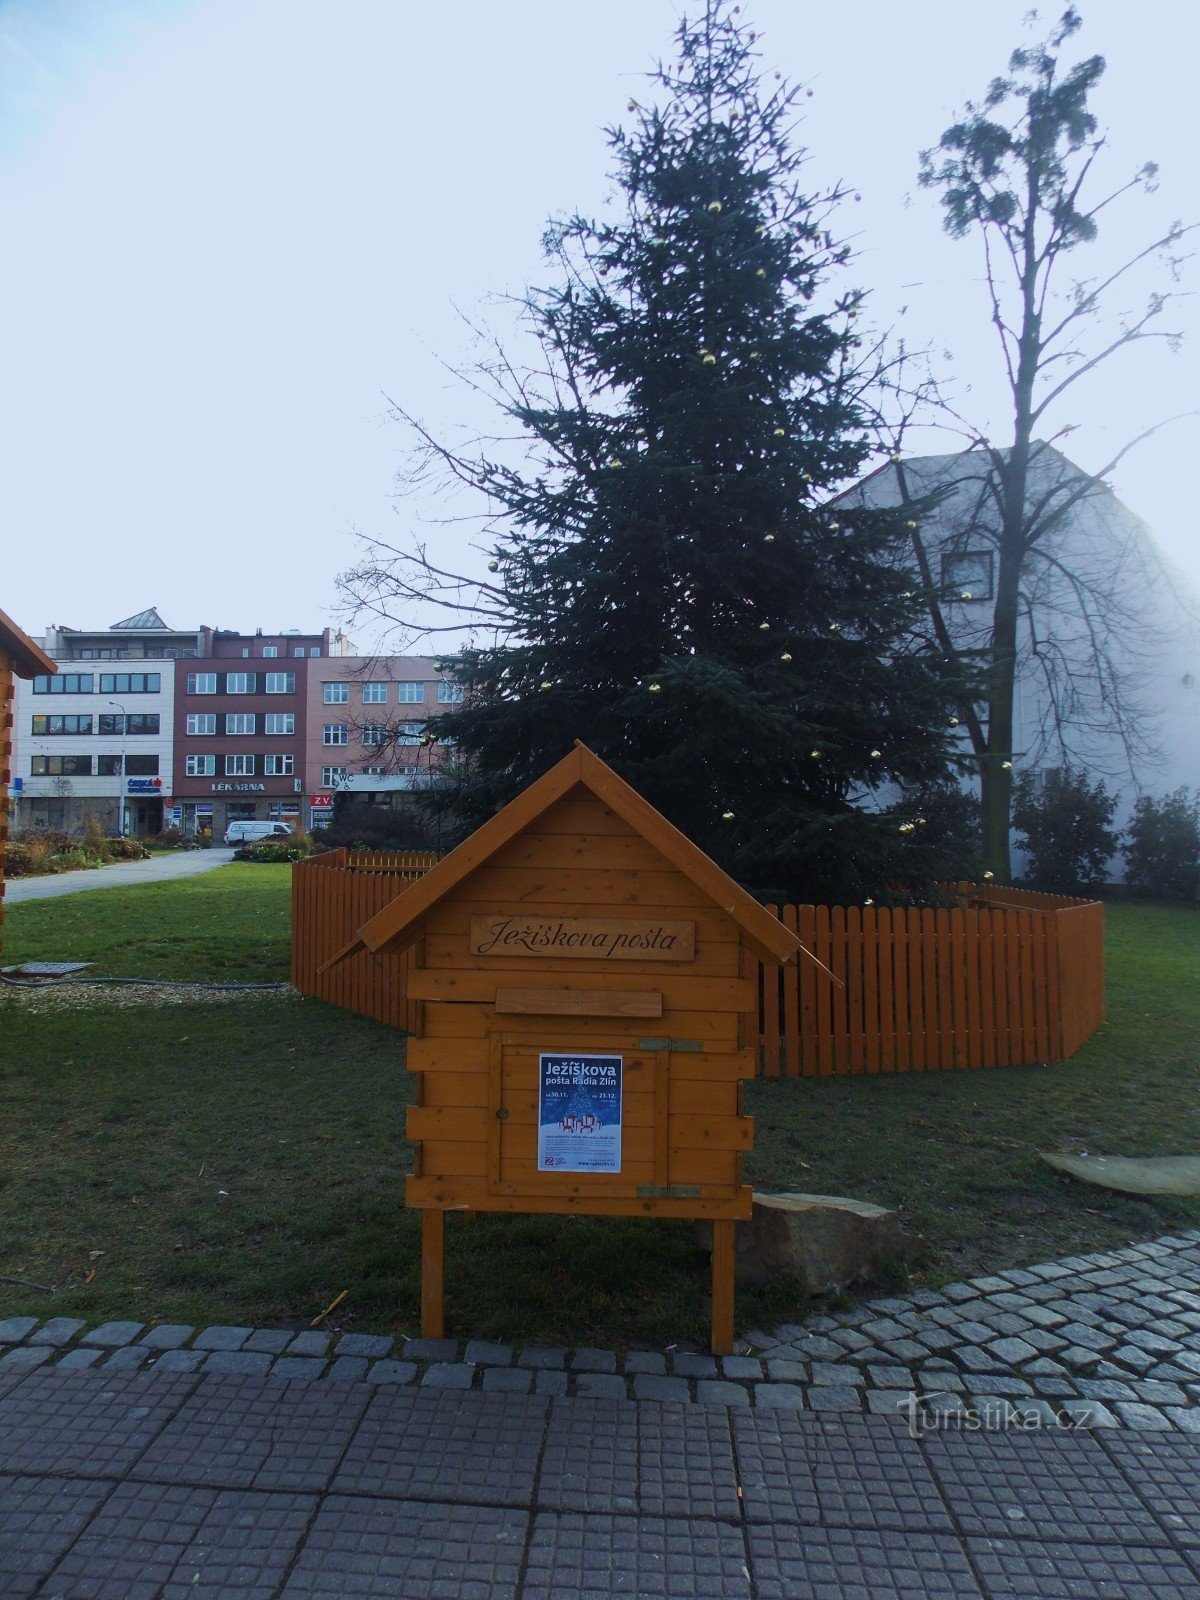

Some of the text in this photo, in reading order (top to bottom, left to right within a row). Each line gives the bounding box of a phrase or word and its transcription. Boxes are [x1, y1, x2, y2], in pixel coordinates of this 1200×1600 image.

[338, 773, 354, 782] WC
[211, 781, 266, 791] LÉKÁRNA
[477, 918, 678, 957] Ježíškova pošta
[545, 1061, 617, 1076] Ježíškova
[545, 1076, 616, 1086] pošta Radia Zlín
